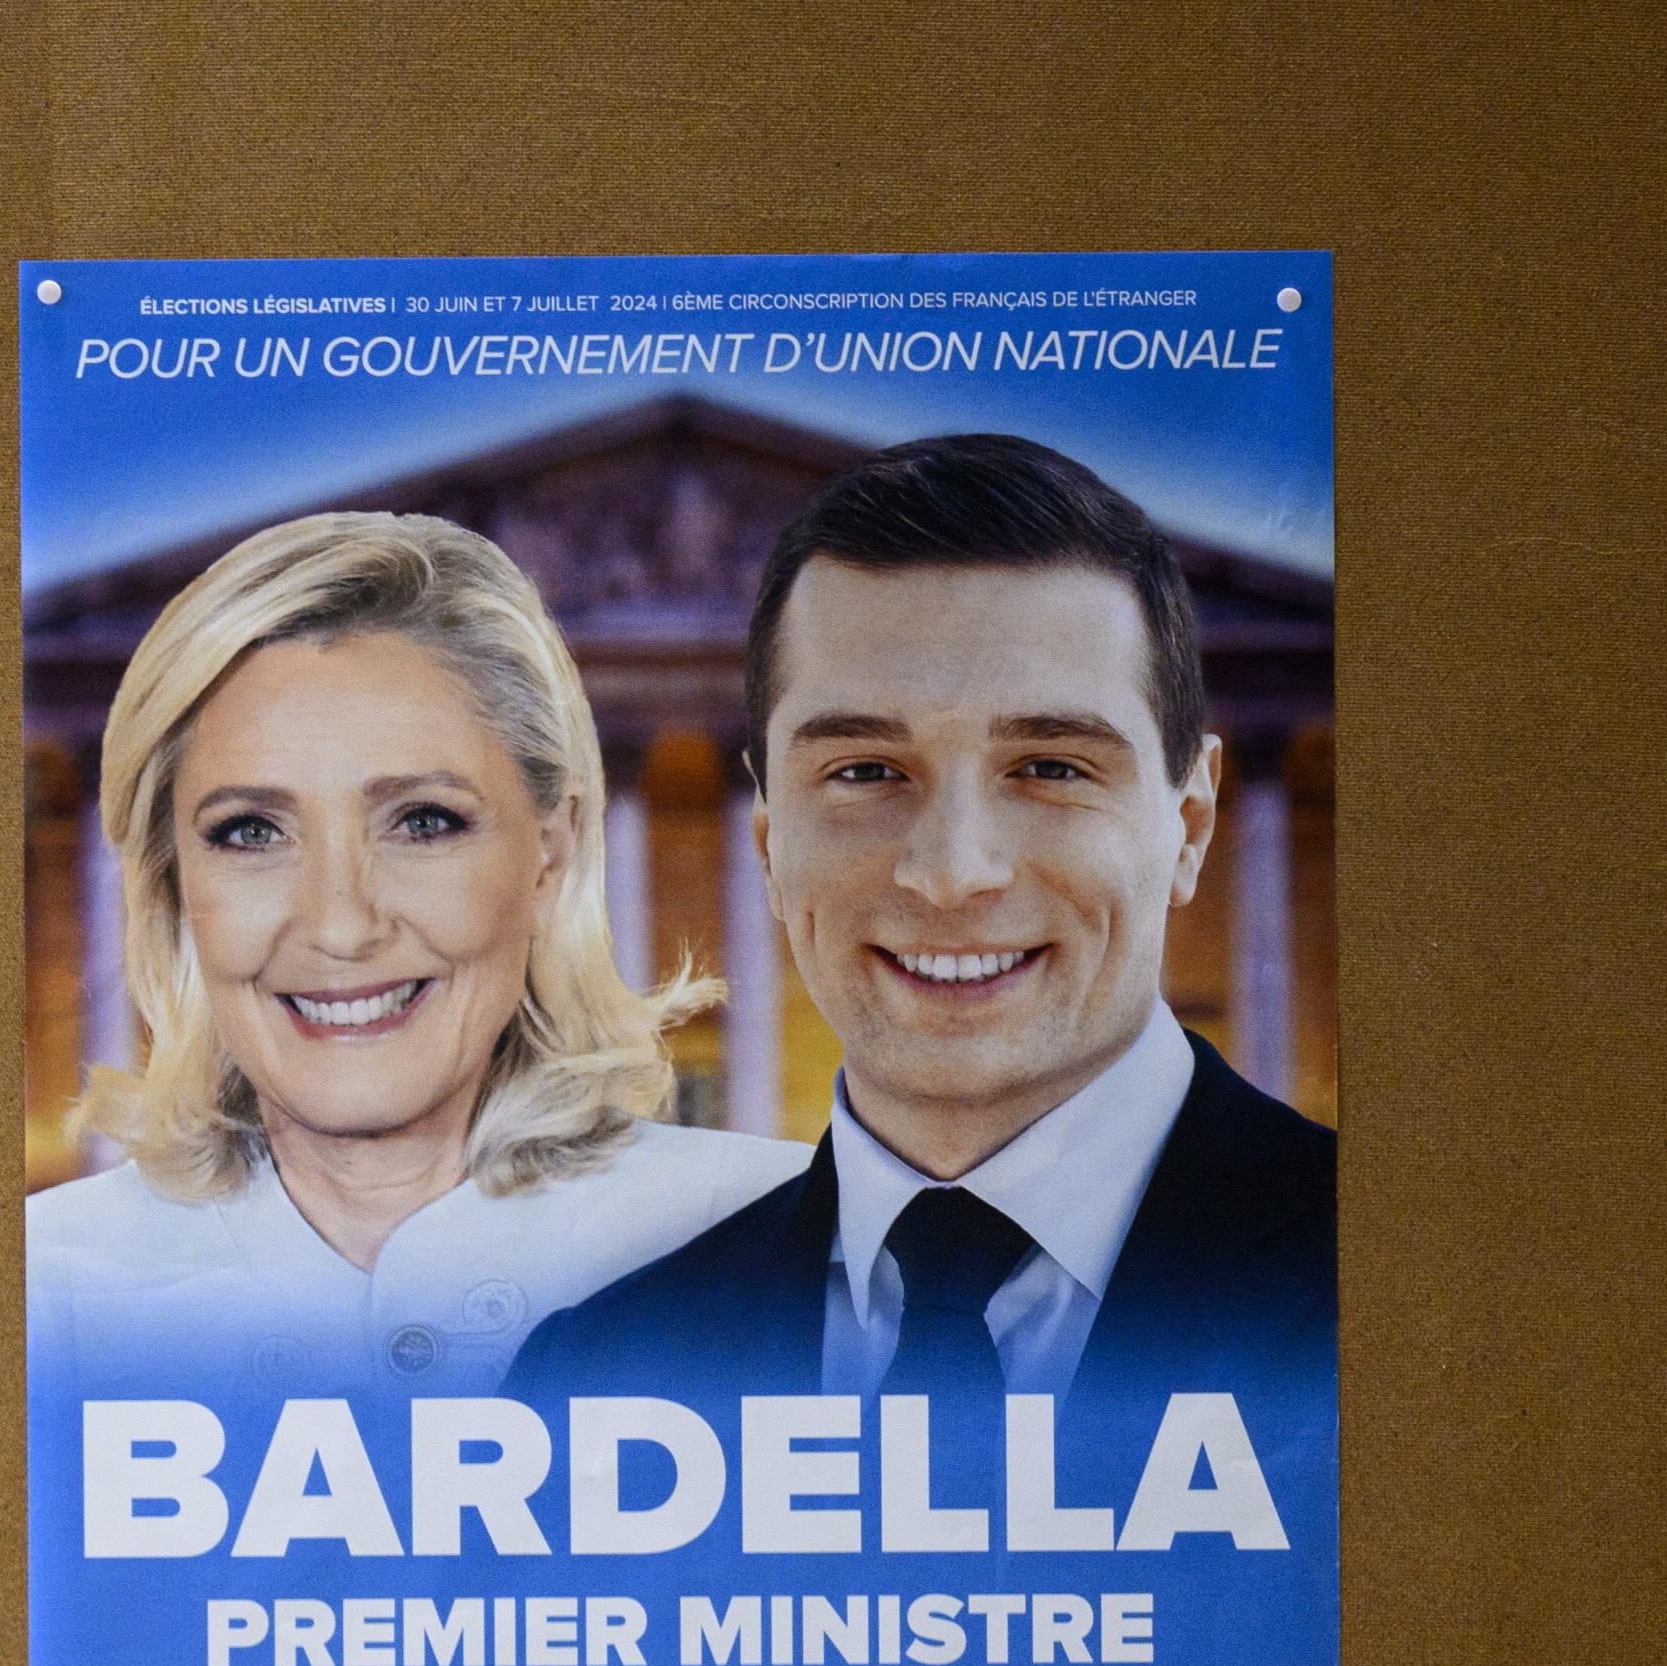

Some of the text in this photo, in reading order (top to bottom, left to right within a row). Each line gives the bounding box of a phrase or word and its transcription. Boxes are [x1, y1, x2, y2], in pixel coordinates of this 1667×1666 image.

[139, 296, 249, 316] ÉLECTIONS
[252, 295, 387, 315] LÉGISLATIVES
[405, 297, 429, 314] 30
[434, 297, 478, 314] JUIN
[482, 297, 506, 313] ET
[511, 296, 523, 312] 7
[527, 295, 599, 312] JUILLET
[609, 295, 658, 312] 2024
[671, 291, 723, 311] 6ÈME
[728, 292, 904, 311] CIRCONSCRIPTION
[908, 292, 947, 309] DES
[952, 291, 1048, 313] FRANÇAIS
[1051, 292, 1076, 308] DE
[1082, 289, 1197, 308] L'ÉTRANGER
[75, 328, 1283, 380] POUR UN GOUVERNEMENT D'UNION NATIONALE
[81, 1392, 1291, 1560] BARDELLA
